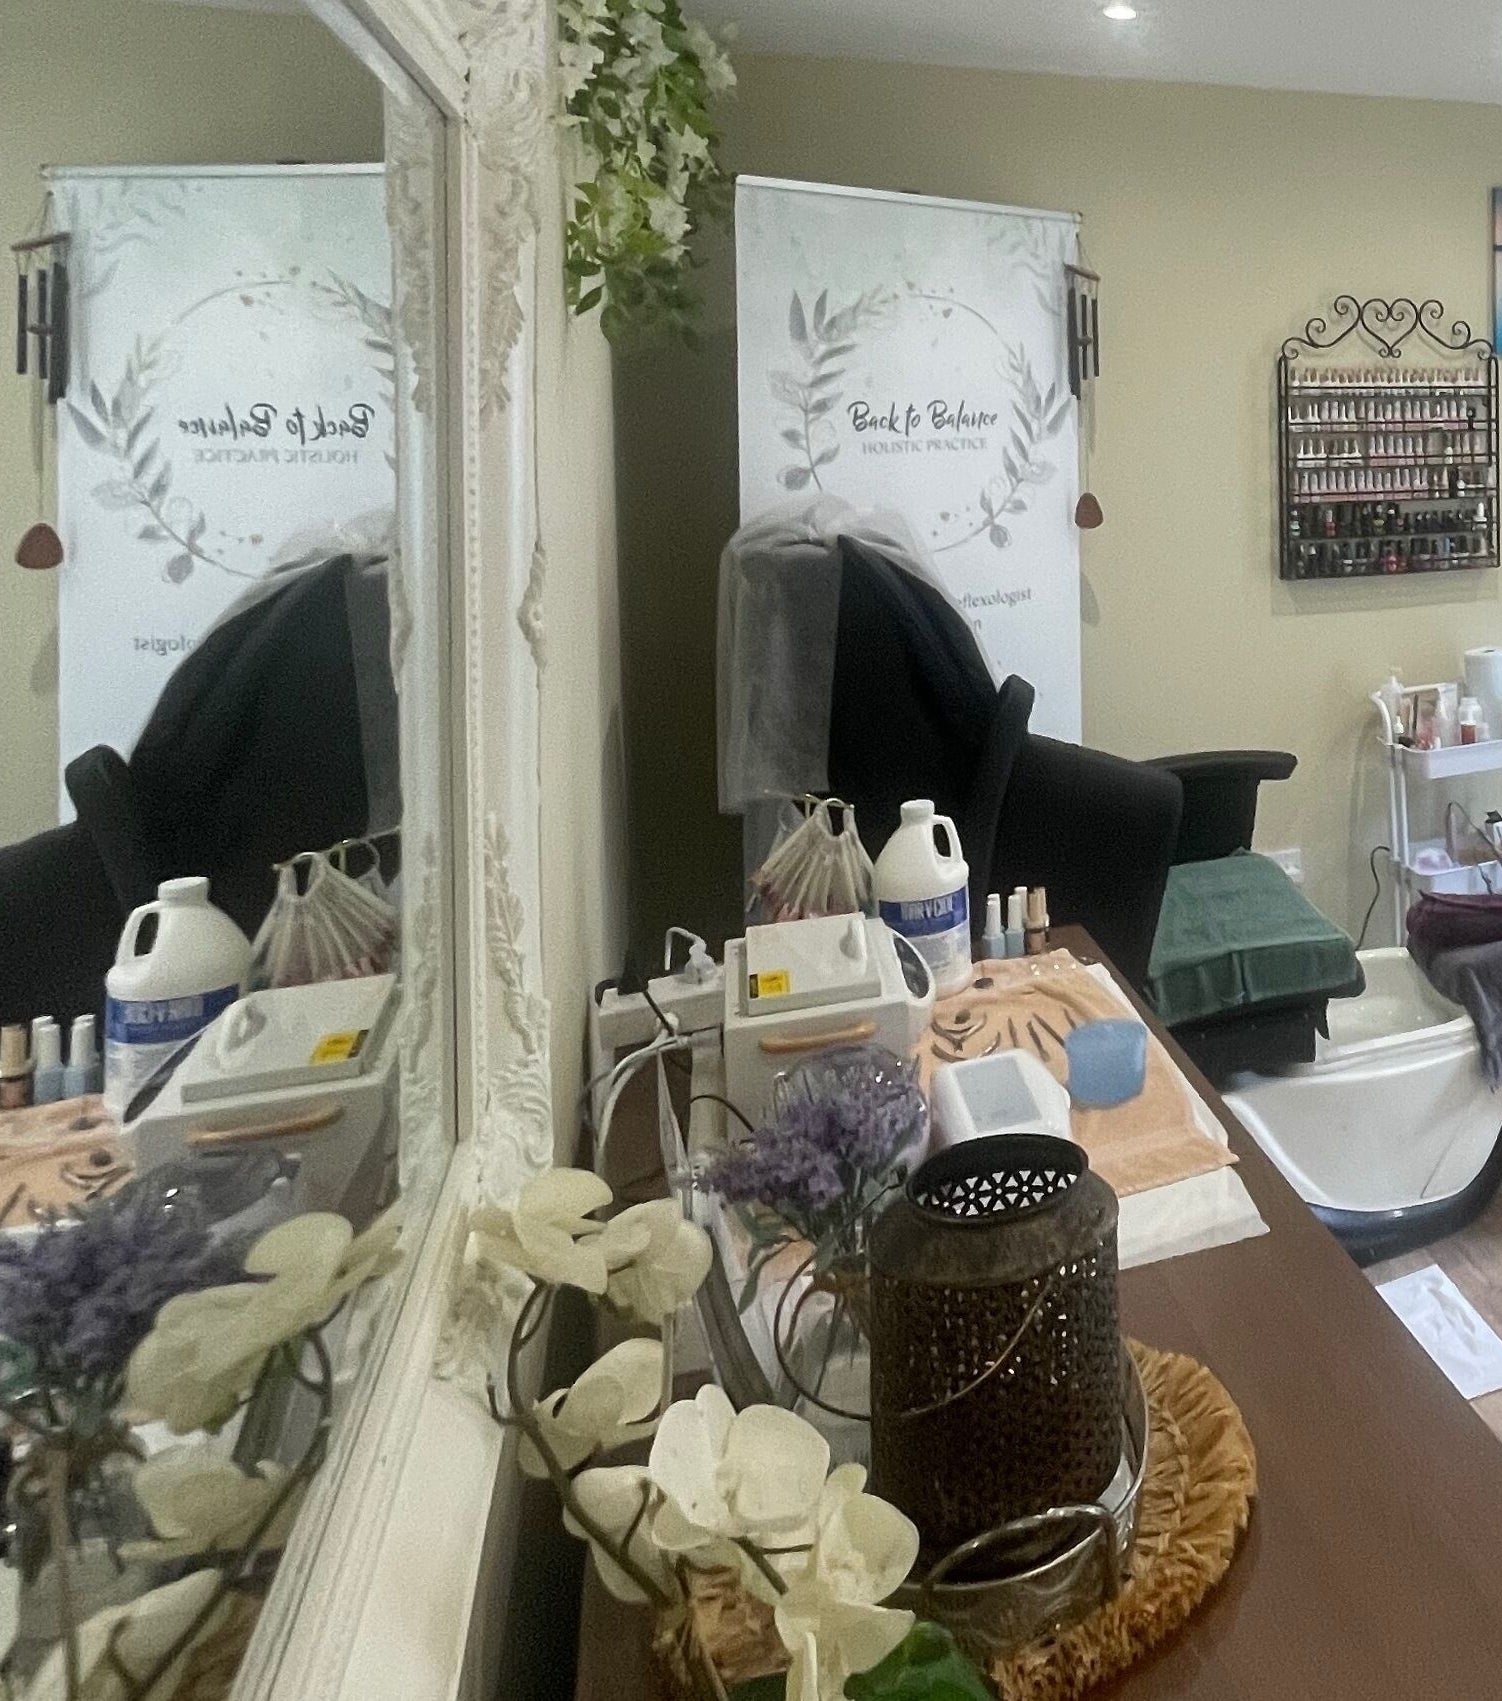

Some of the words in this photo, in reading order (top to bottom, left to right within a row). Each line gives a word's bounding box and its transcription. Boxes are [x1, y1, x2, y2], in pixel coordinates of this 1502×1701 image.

[847, 400, 902, 434] Back
[904, 403, 921, 437] to
[926, 399, 998, 432] Balance
[862, 440, 923, 454] HOLISTIC
[927, 437, 988, 452] PRACTICE
[959, 588, 1032, 608] flexologist
